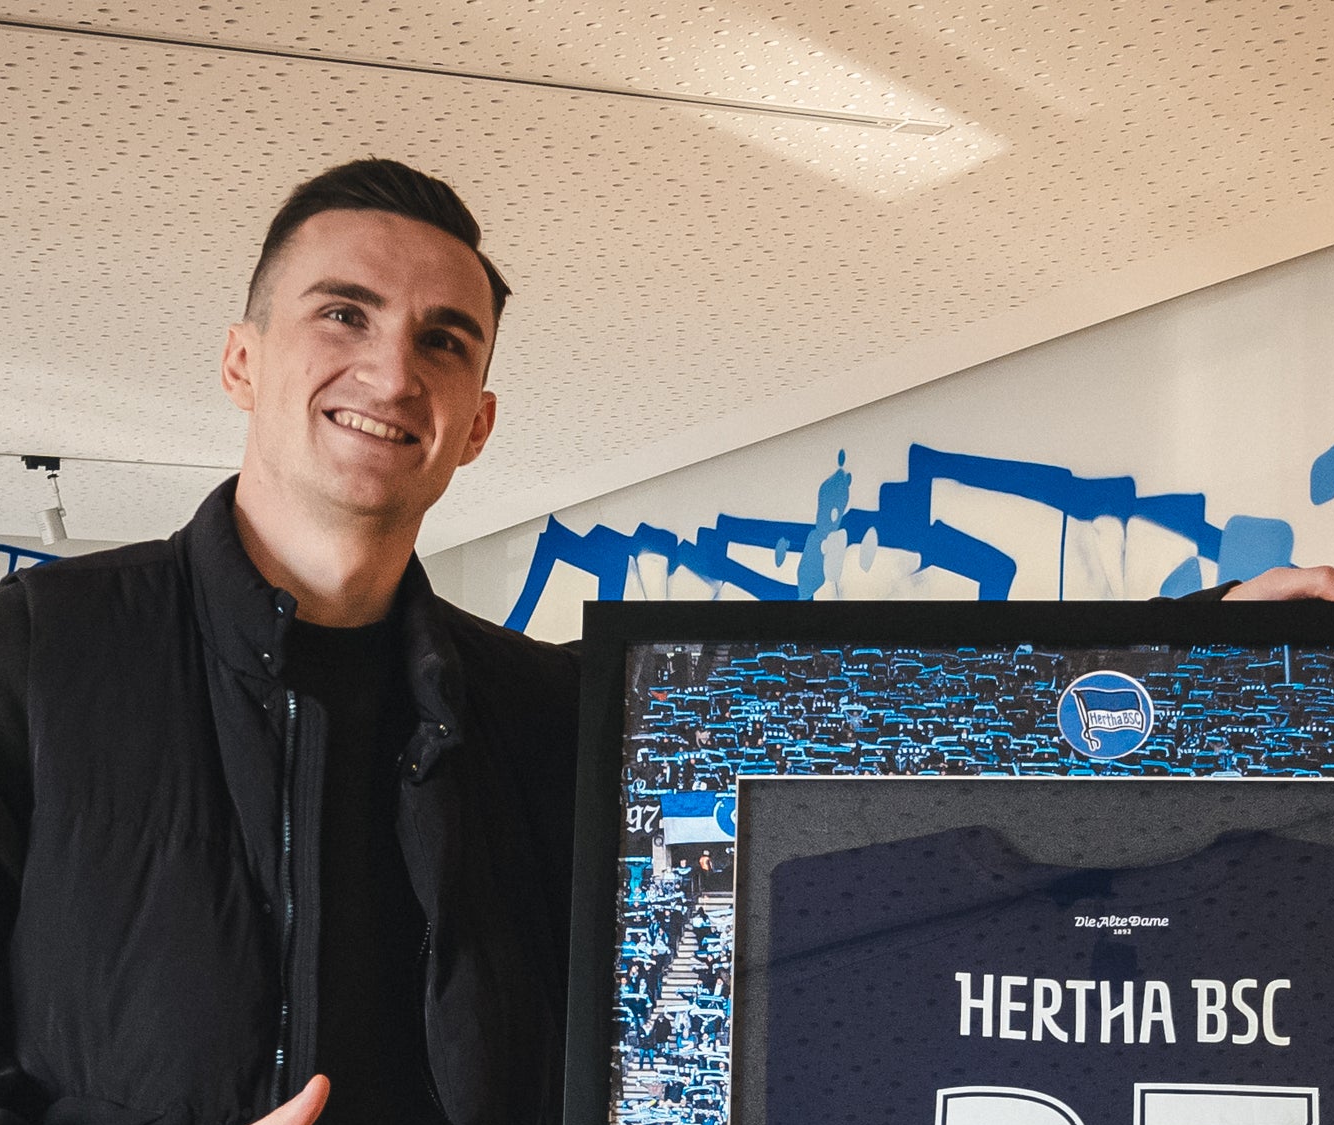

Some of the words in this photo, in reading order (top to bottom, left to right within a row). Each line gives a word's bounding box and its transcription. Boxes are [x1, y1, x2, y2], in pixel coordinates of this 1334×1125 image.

[1089, 711, 1122, 727] Hertha
[1122, 711, 1142, 726] BSC
[626, 804, 661, 834] 97
[1074, 916, 1096, 928] Die
[1096, 914, 1128, 929] Alte
[1128, 915, 1170, 927] Dame
[955, 972, 1176, 1044] HERTHA
[1191, 978, 1292, 1046] BSC
